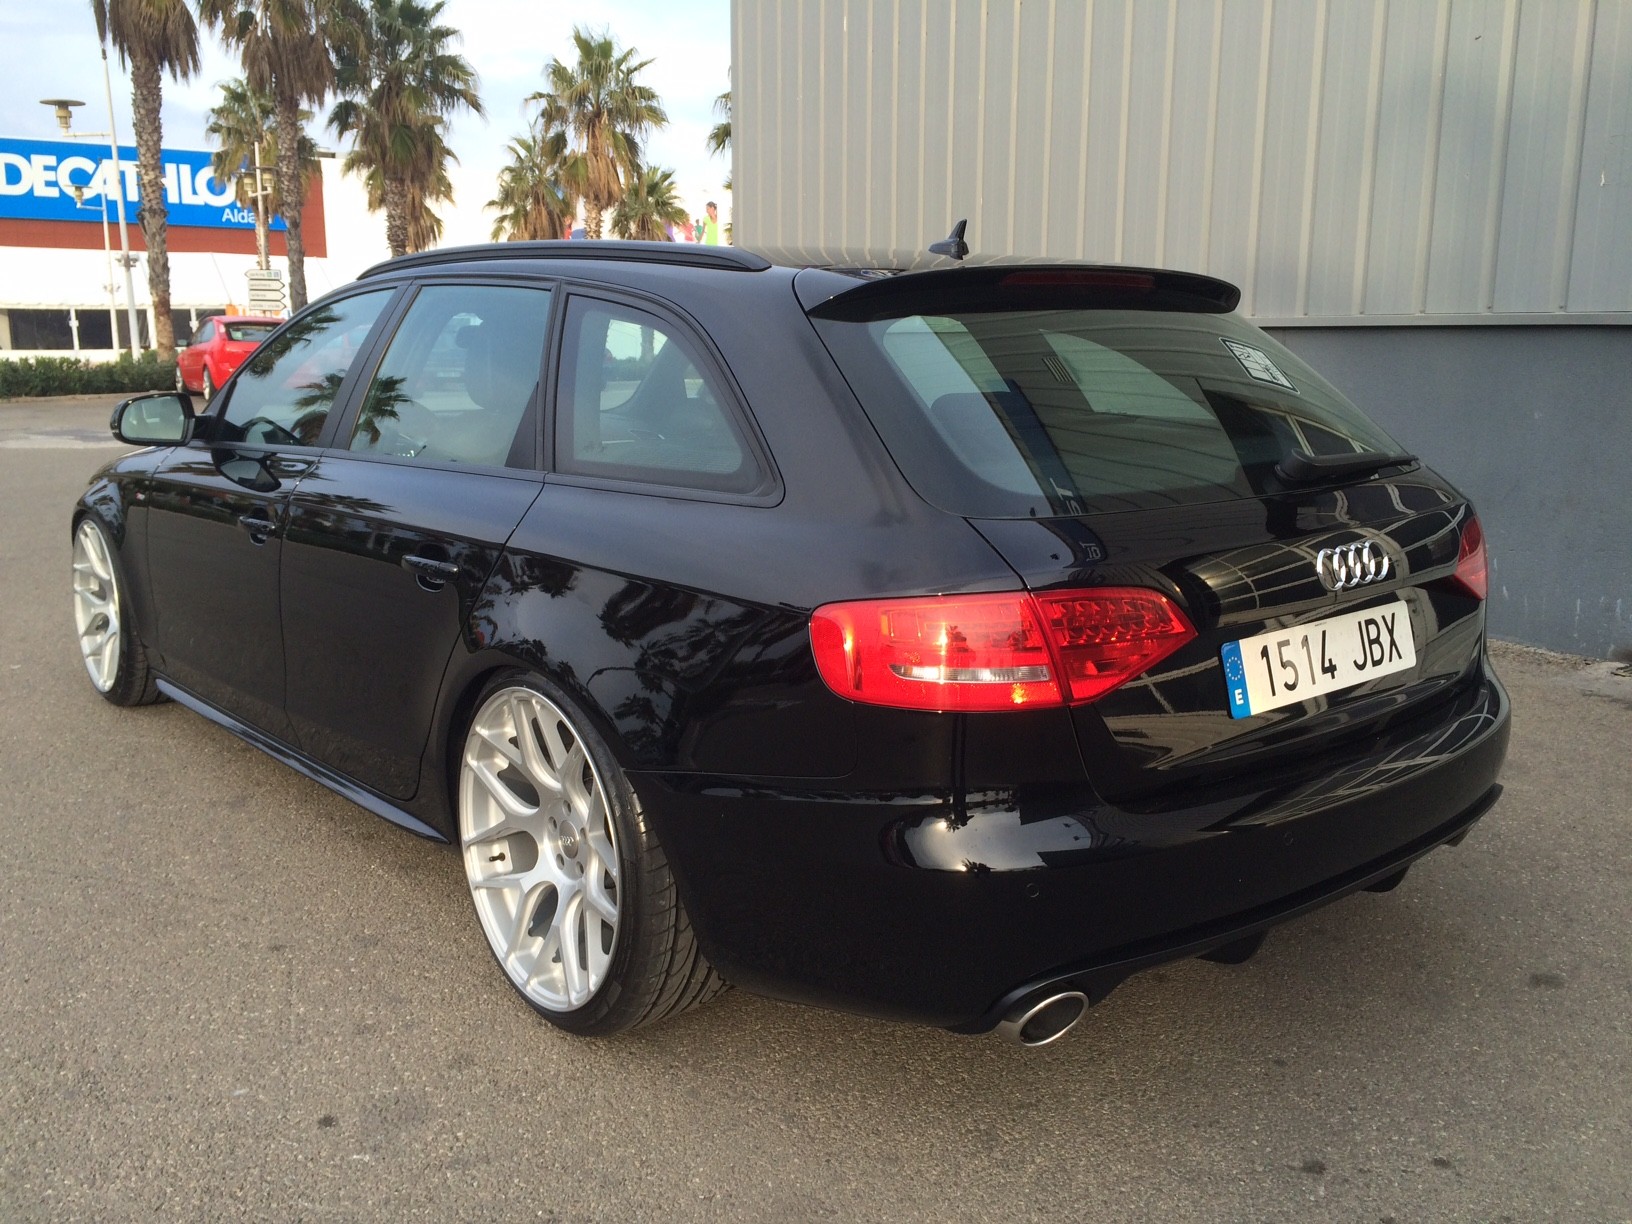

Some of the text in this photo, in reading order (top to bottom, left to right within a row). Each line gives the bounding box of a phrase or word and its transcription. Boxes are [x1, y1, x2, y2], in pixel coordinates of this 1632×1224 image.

[0, 153, 243, 208] DECATHLO
[221, 208, 272, 224] Alda
[1260, 612, 1403, 697] 1514 JBX
[1234, 688, 1245, 705] E
